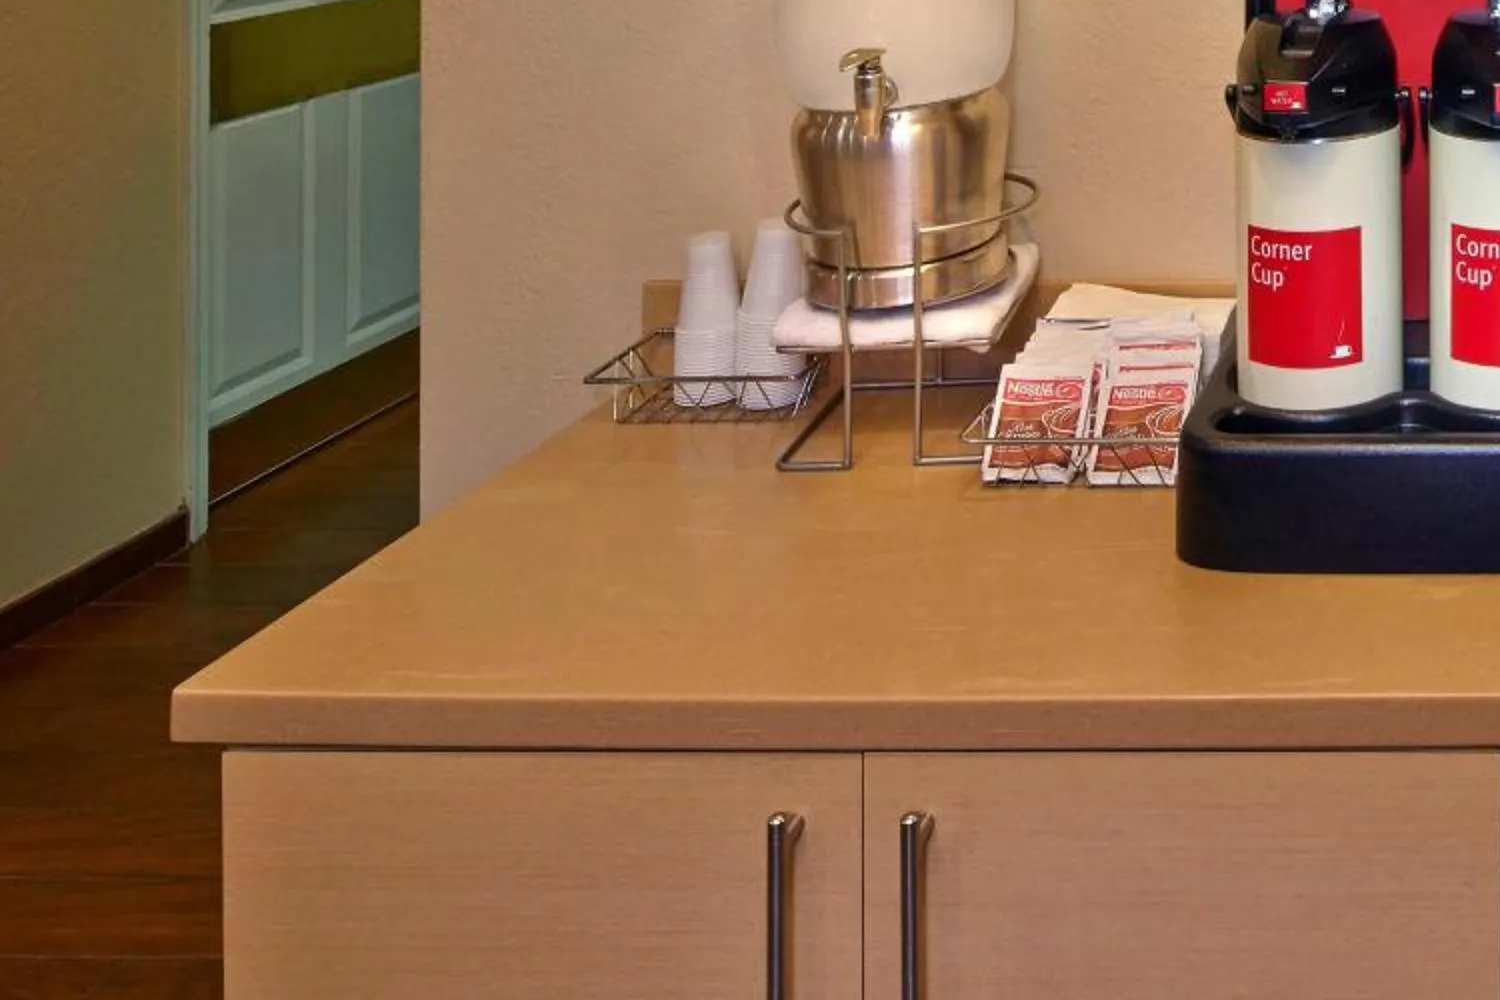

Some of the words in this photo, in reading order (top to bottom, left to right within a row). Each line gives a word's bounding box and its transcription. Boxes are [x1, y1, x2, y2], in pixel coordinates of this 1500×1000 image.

[1251, 235, 1313, 261] Corner
[1251, 262, 1284, 292] Cup
[1456, 261, 1493, 291] Cup
